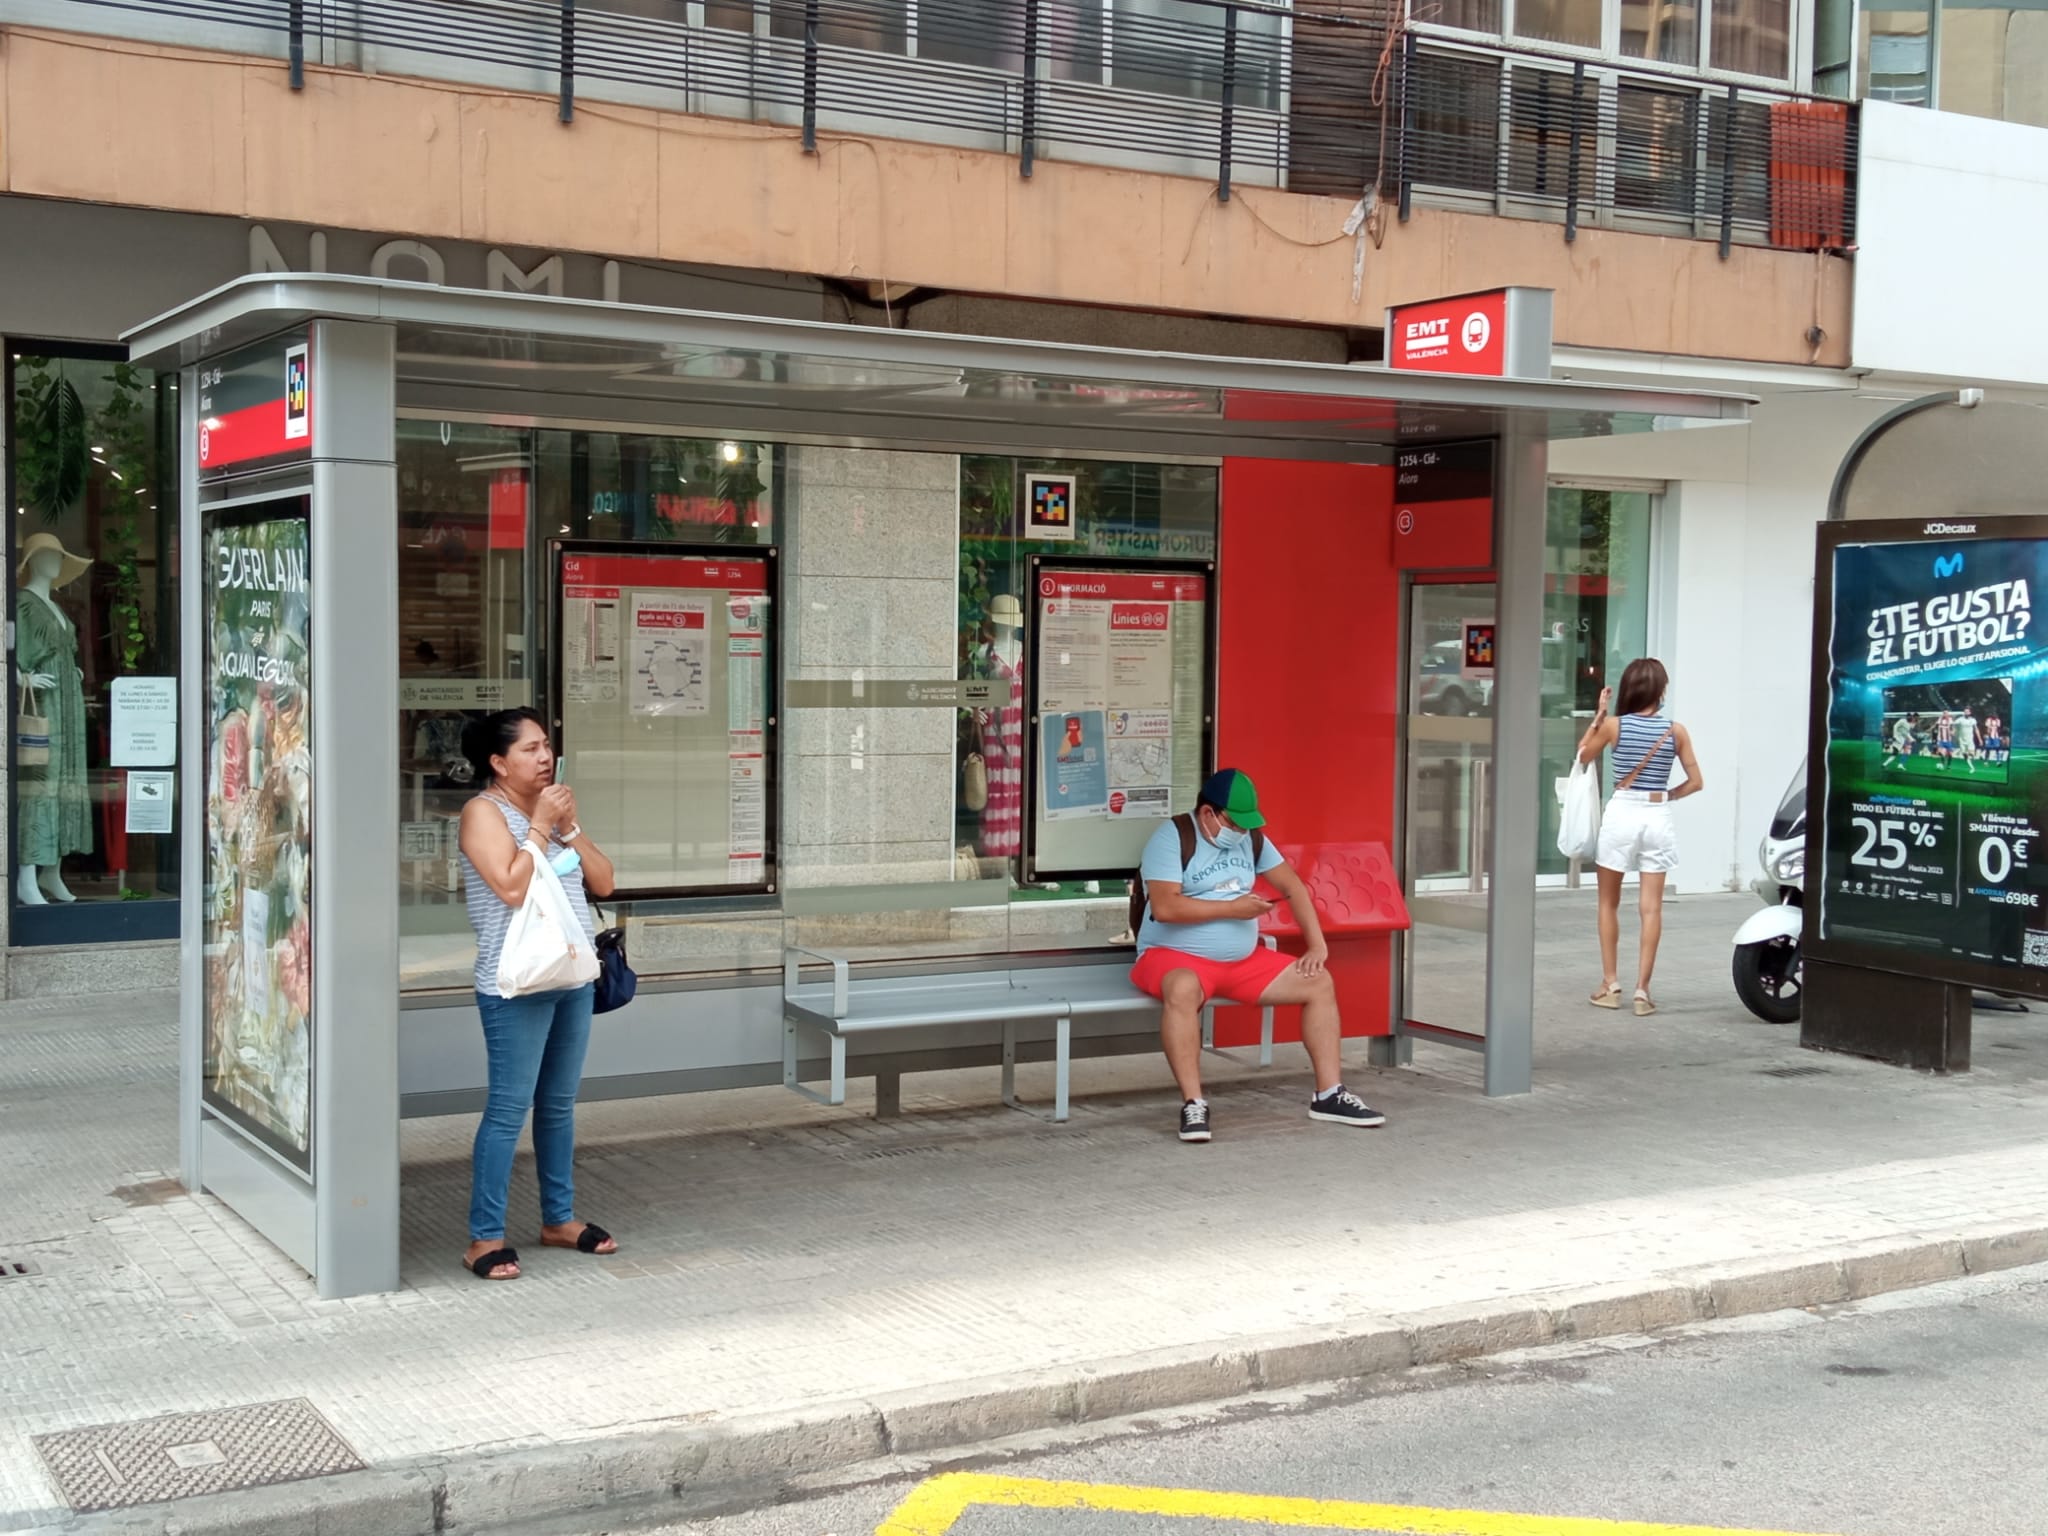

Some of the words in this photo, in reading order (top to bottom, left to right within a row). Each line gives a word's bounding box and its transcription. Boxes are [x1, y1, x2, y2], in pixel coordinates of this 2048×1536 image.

[1407, 319, 1450, 338] EMT
[1923, 523, 1976, 534] JCDecaux
[565, 561, 579, 571] Cid
[1057, 583, 1106, 593] IORMACIÓ
[250, 600, 271, 618] PARIS
[1867, 602, 1919, 639] ¿TE
[1925, 579, 2030, 627] GUSTA
[1866, 639, 1898, 666] EL
[1903, 611, 2031, 660] FÚTBOL?
[1852, 803, 1874, 812] TODO
[1875, 805, 1884, 813] EL
[1969, 823, 1999, 833] SMART
[1191, 859, 1229, 884] SPORTS
